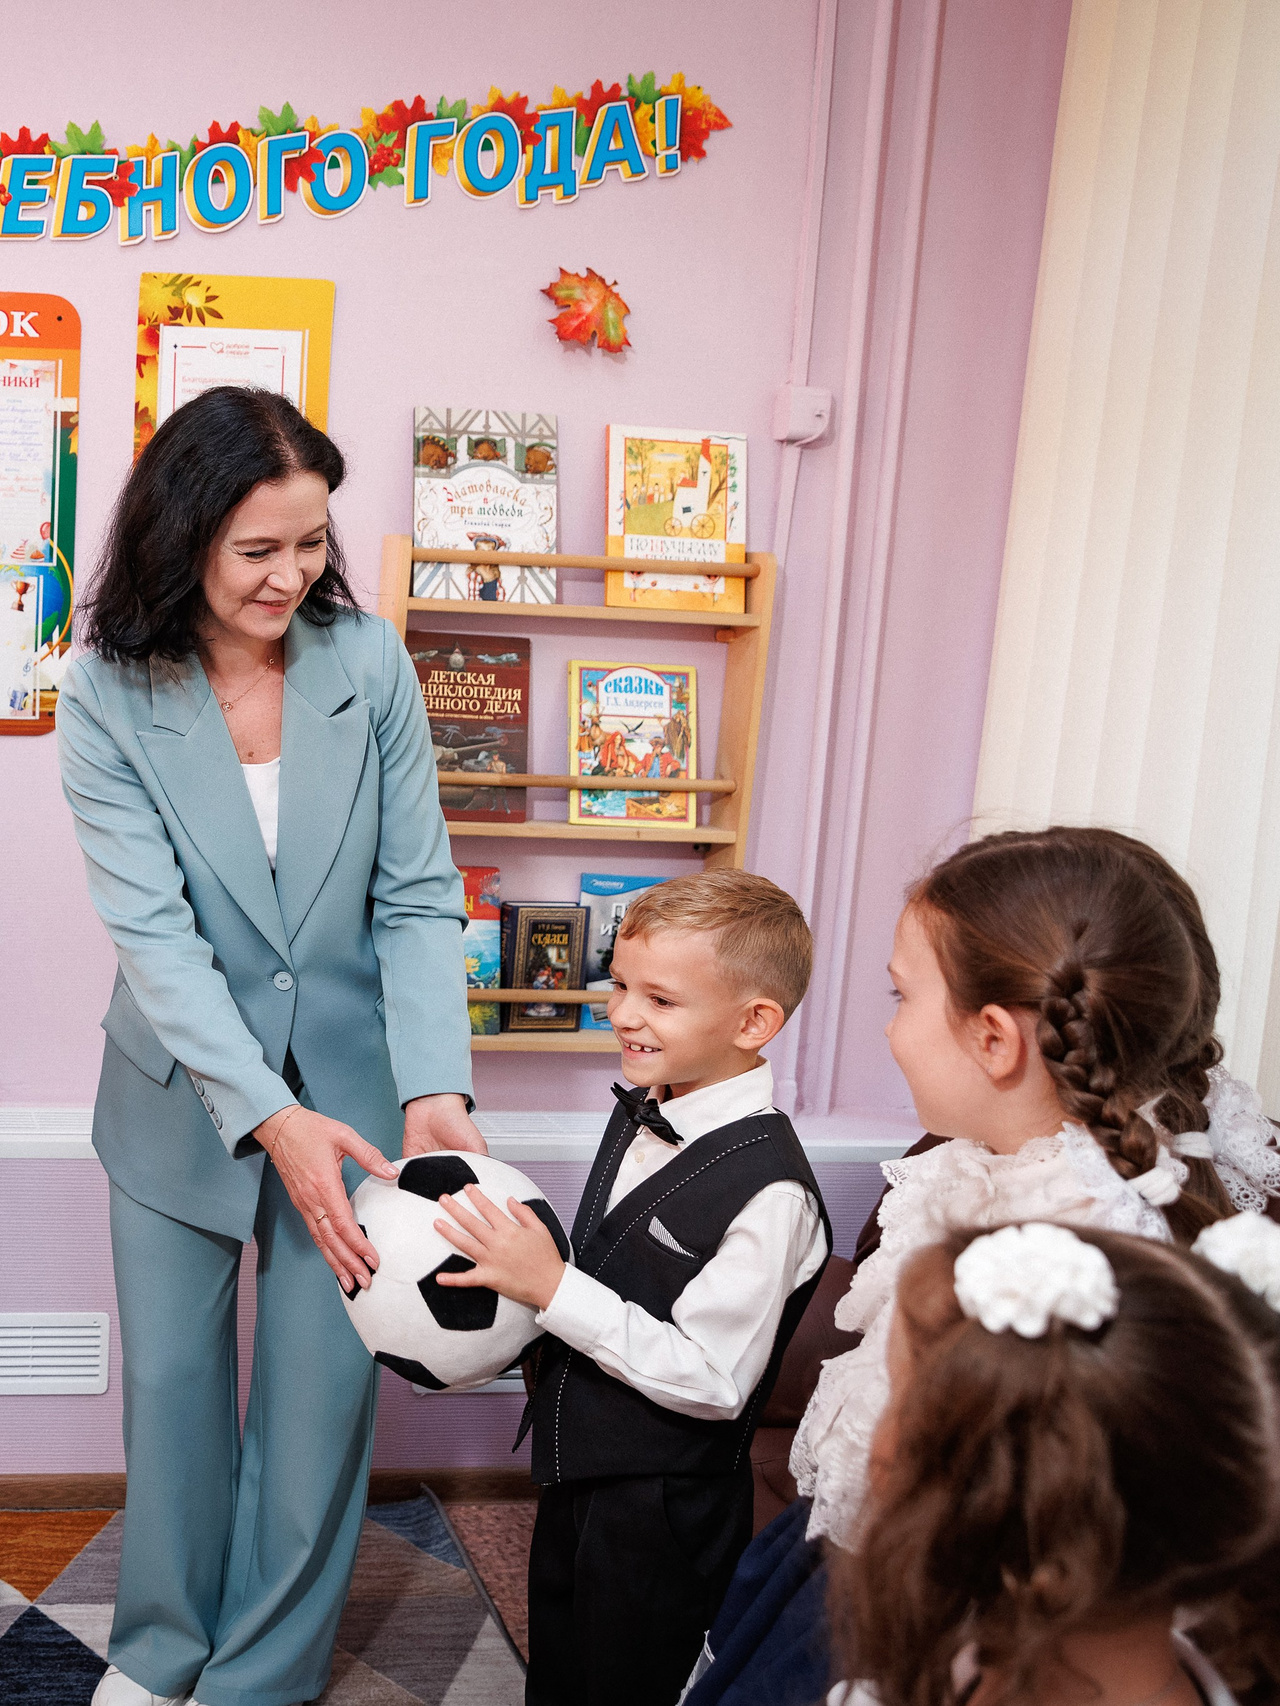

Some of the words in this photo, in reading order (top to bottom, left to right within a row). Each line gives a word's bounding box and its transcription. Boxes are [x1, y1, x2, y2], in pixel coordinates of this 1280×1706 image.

[403, 94, 683, 210] ГОДА!
[427, 670, 496, 686] ДЕТСКАЯ
[421, 683, 522, 702] ЦИКЛОПЕДИЯ
[423, 696, 481, 712] ЕННОГО
[483, 700, 522, 715] ДЕЛА
